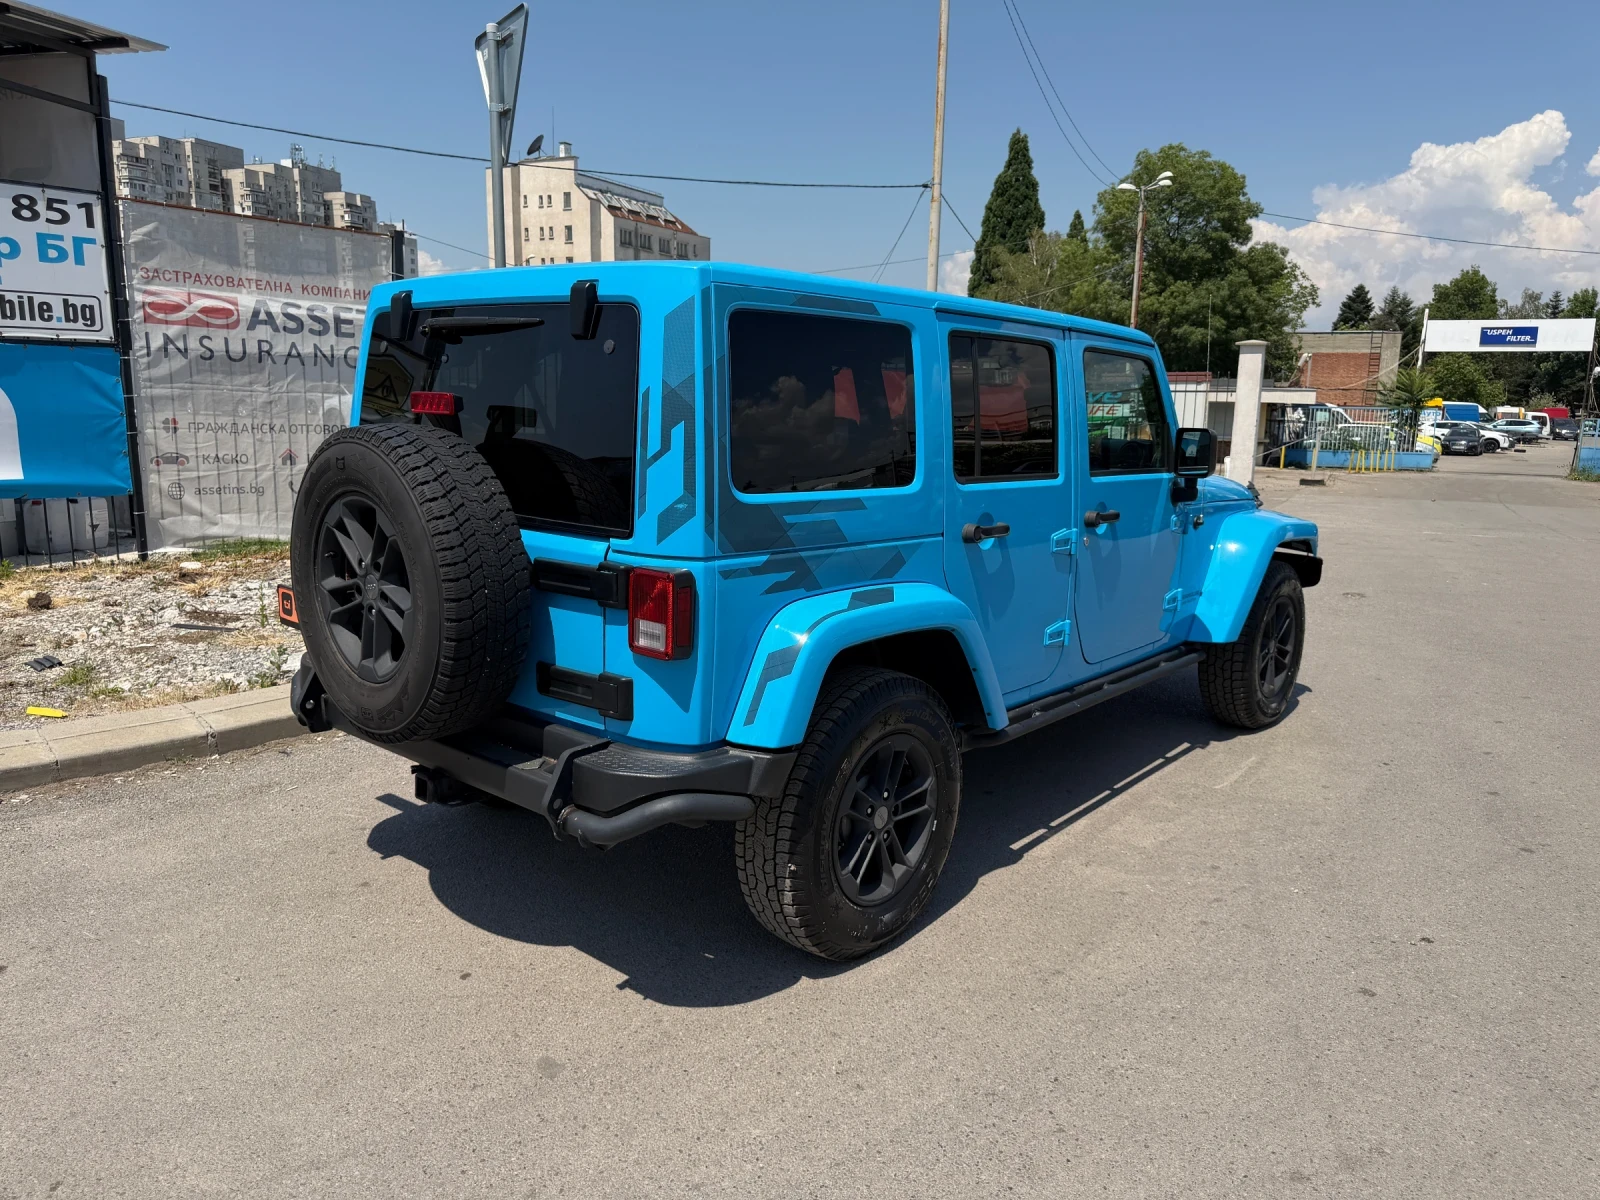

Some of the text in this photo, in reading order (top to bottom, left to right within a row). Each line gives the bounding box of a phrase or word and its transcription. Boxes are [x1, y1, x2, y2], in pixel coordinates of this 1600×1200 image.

[11, 193, 96, 229] 851
[35, 231, 97, 267] БГ
[140, 266, 293, 294] ЗАСТРАХОВАТЕЛНА
[0, 294, 96, 328] bile.bg
[144, 331, 360, 369] INSURANC
[202, 453, 249, 466] КАСКО
[194, 483, 265, 497] assetins.bg
